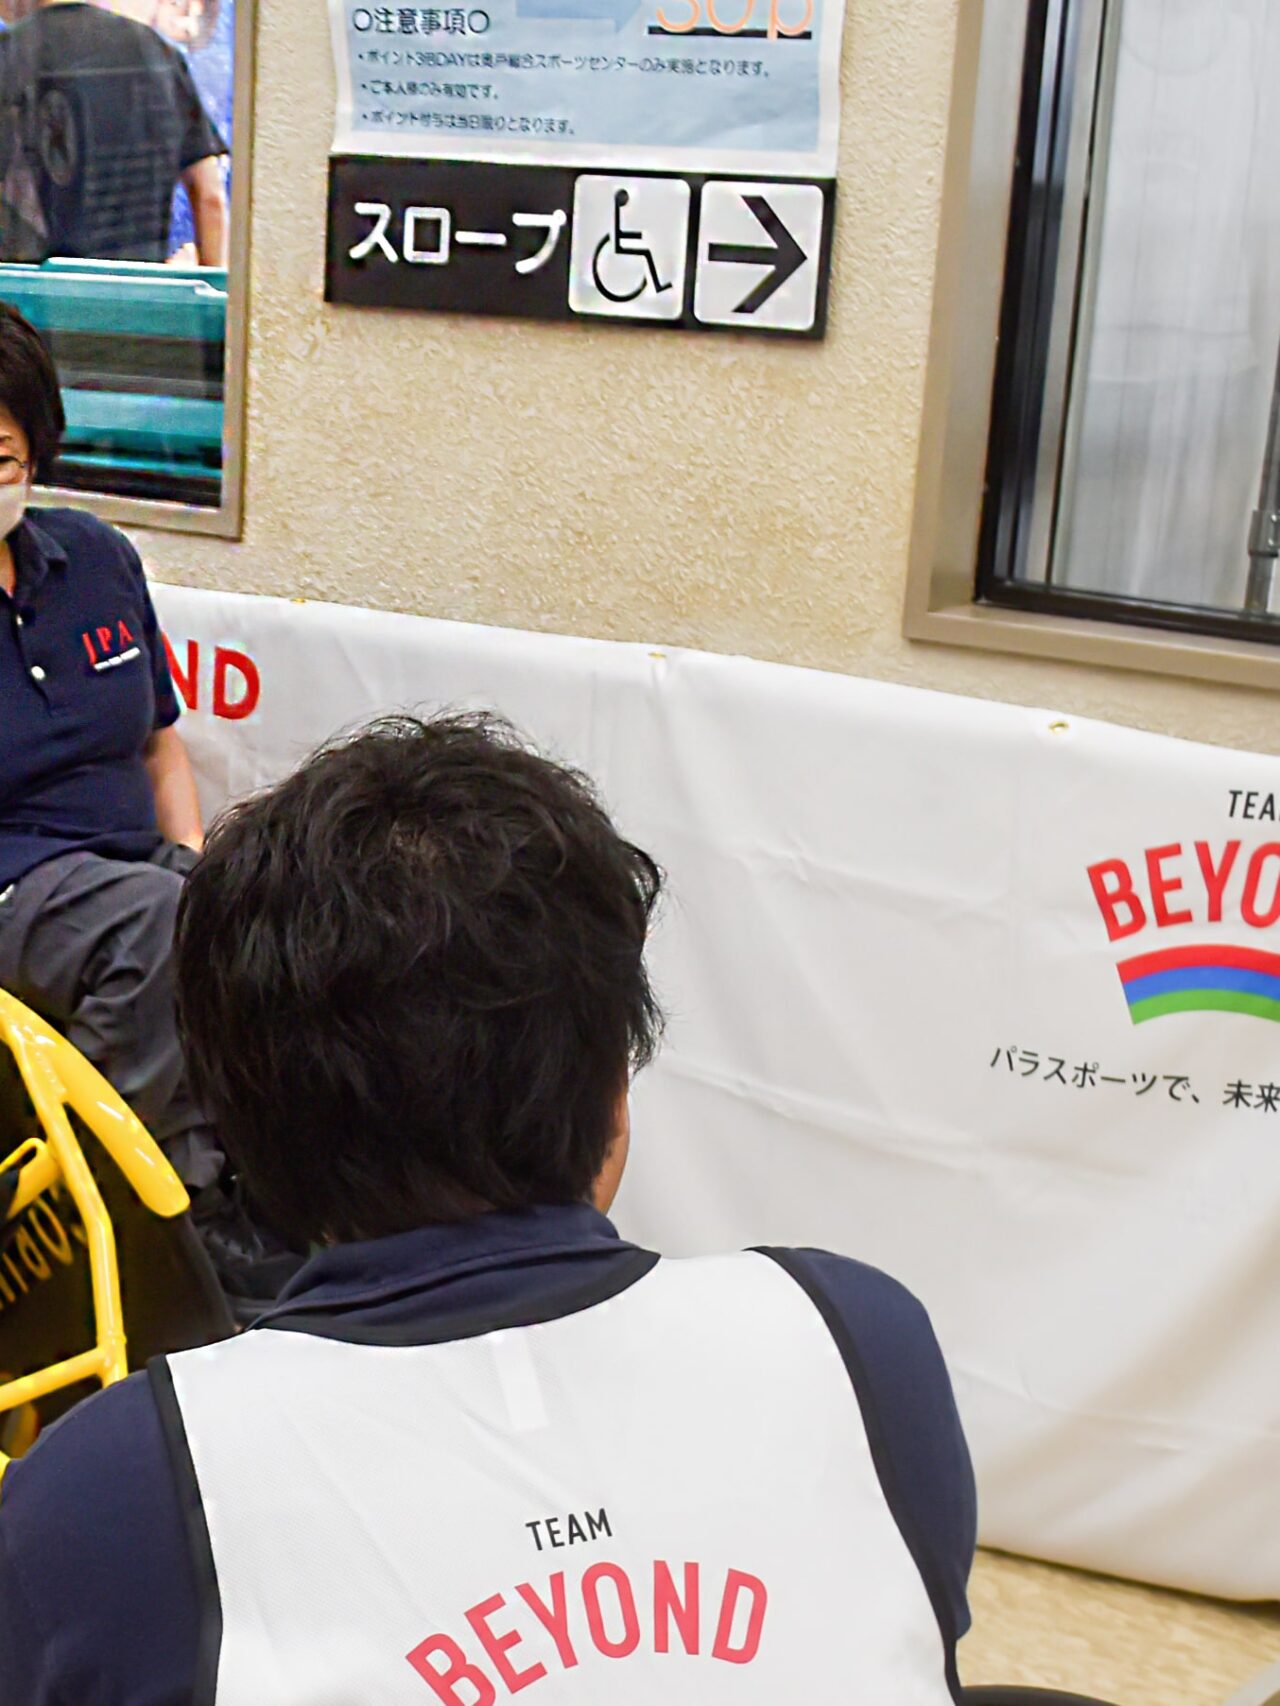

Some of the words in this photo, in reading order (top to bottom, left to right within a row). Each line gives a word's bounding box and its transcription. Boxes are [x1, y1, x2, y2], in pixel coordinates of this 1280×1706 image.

[348, 201, 567, 276] スロープ
[1228, 790, 1280, 822] TEA
[525, 1507, 613, 1551] TEAM
[404, 1559, 768, 1706] BEYOND
